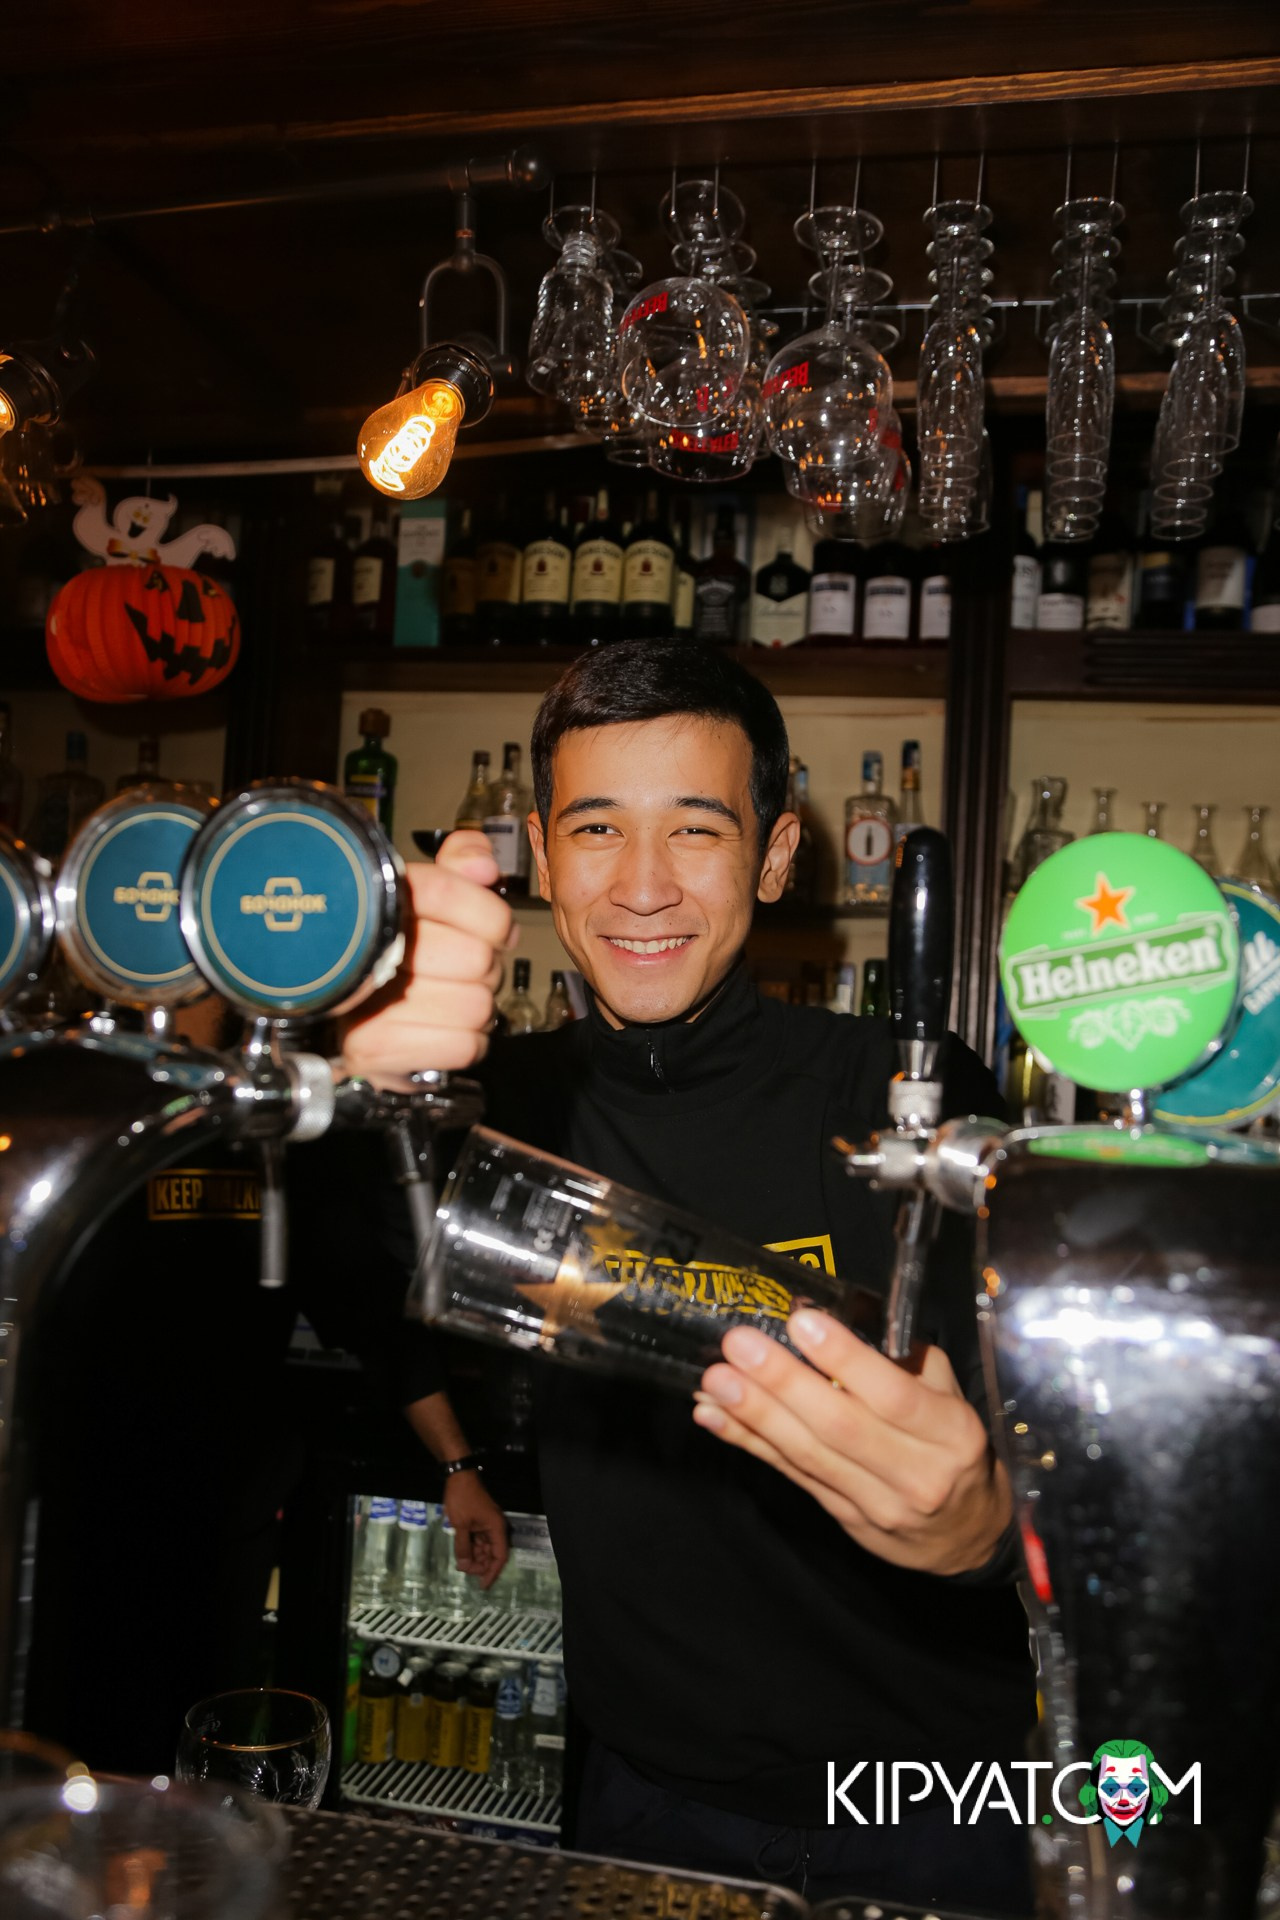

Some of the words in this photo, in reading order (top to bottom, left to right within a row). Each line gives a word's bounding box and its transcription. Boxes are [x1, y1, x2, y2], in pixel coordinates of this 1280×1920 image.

[1019, 933, 1222, 1006] Heineken
[155, 1177, 204, 1211] KEEP
[207, 1178, 261, 1211] WALKI
